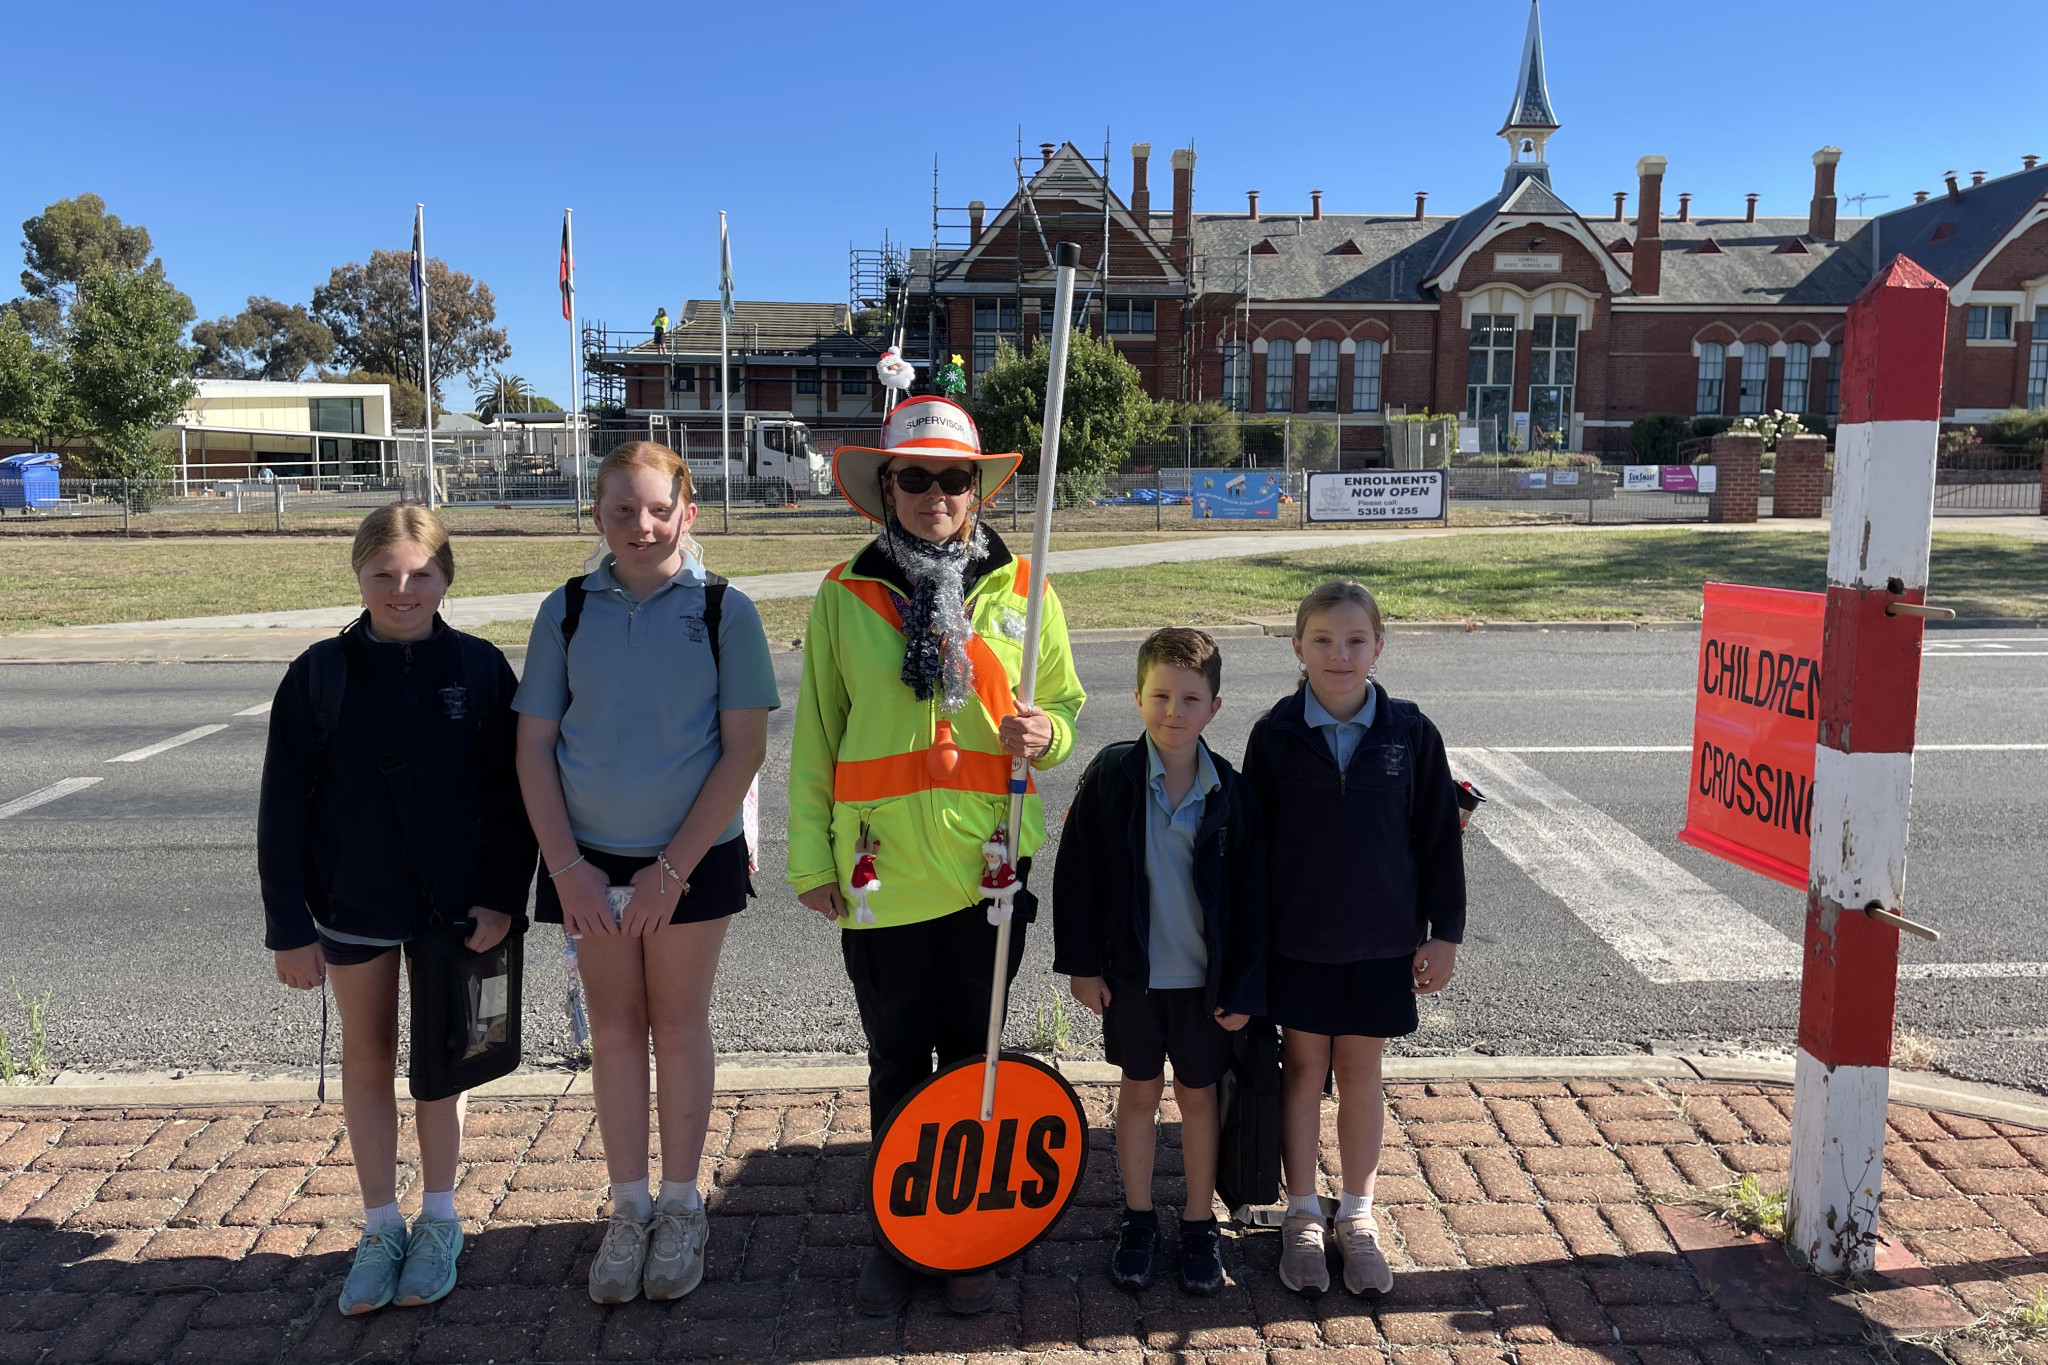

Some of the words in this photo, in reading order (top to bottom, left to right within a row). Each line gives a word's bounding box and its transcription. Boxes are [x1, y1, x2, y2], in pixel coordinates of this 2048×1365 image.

[906, 416, 965, 434] SUPERVISOR
[1344, 475, 1438, 486] ENROLMENTS
[1351, 487, 1386, 498] NOW
[1389, 486, 1430, 497] OPEN
[1357, 507, 1387, 516] 5358
[1390, 506, 1419, 515] 1255
[889, 1115, 1067, 1217] STOP
